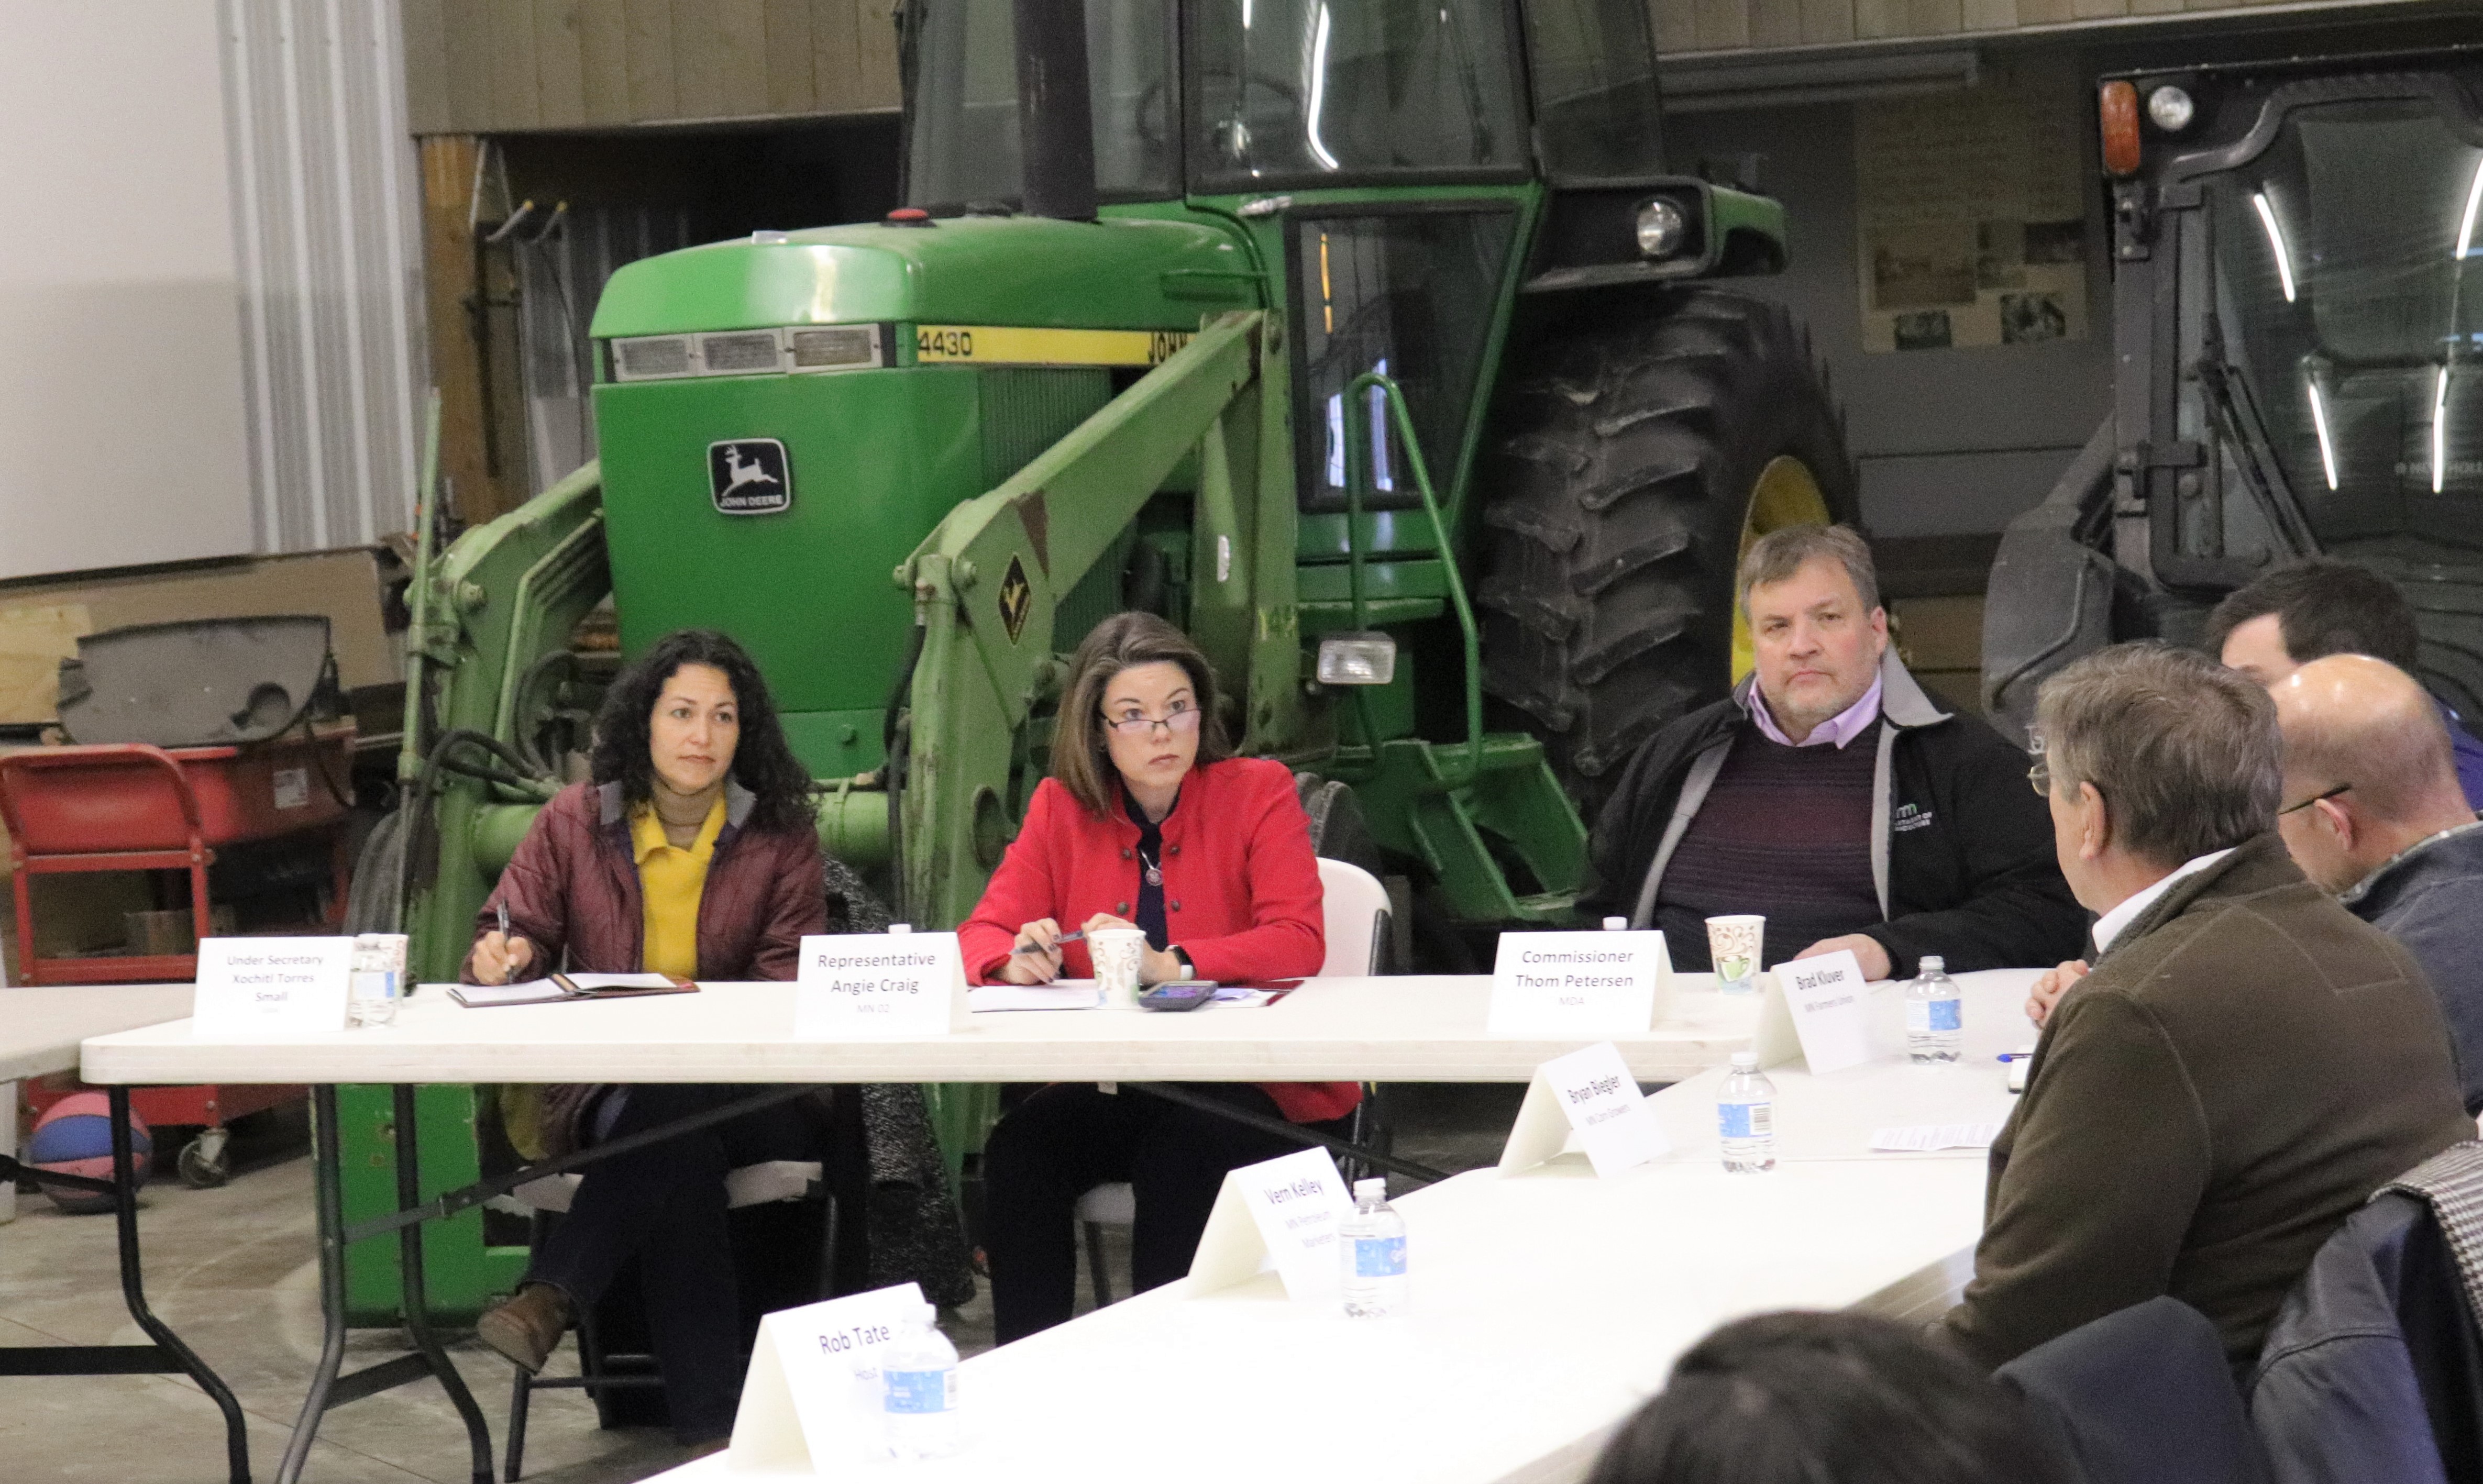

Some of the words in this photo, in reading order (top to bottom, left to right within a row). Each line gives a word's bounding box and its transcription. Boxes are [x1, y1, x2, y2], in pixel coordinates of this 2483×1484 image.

[919, 330, 973, 356] 4430
[720, 497, 747, 507] JOHN
[748, 494, 783, 506] DEERE
[227, 955, 264, 966] Under
[267, 955, 324, 966] Secretary
[818, 953, 936, 970] Representative
[1522, 950, 1634, 964] Commissioner
[232, 973, 273, 983] Xochitl
[277, 973, 315, 983] Torres
[1516, 974, 1560, 987] Thom
[1565, 974, 1634, 987] Petersen
[1795, 972, 1817, 990] Brad
[831, 979, 875, 995] Angie
[880, 978, 919, 994] Craig
[255, 991, 288, 1002] Small
[1559, 997, 1585, 1005] MDA
[1567, 1087, 1594, 1105] Bryan
[1590, 1075, 1621, 1095] Biegler
[1263, 1188, 1293, 1205] Vern
[1289, 1178, 1324, 1199] Kelley
[819, 1331, 851, 1355] Rob
[852, 1325, 891, 1347] Tate
